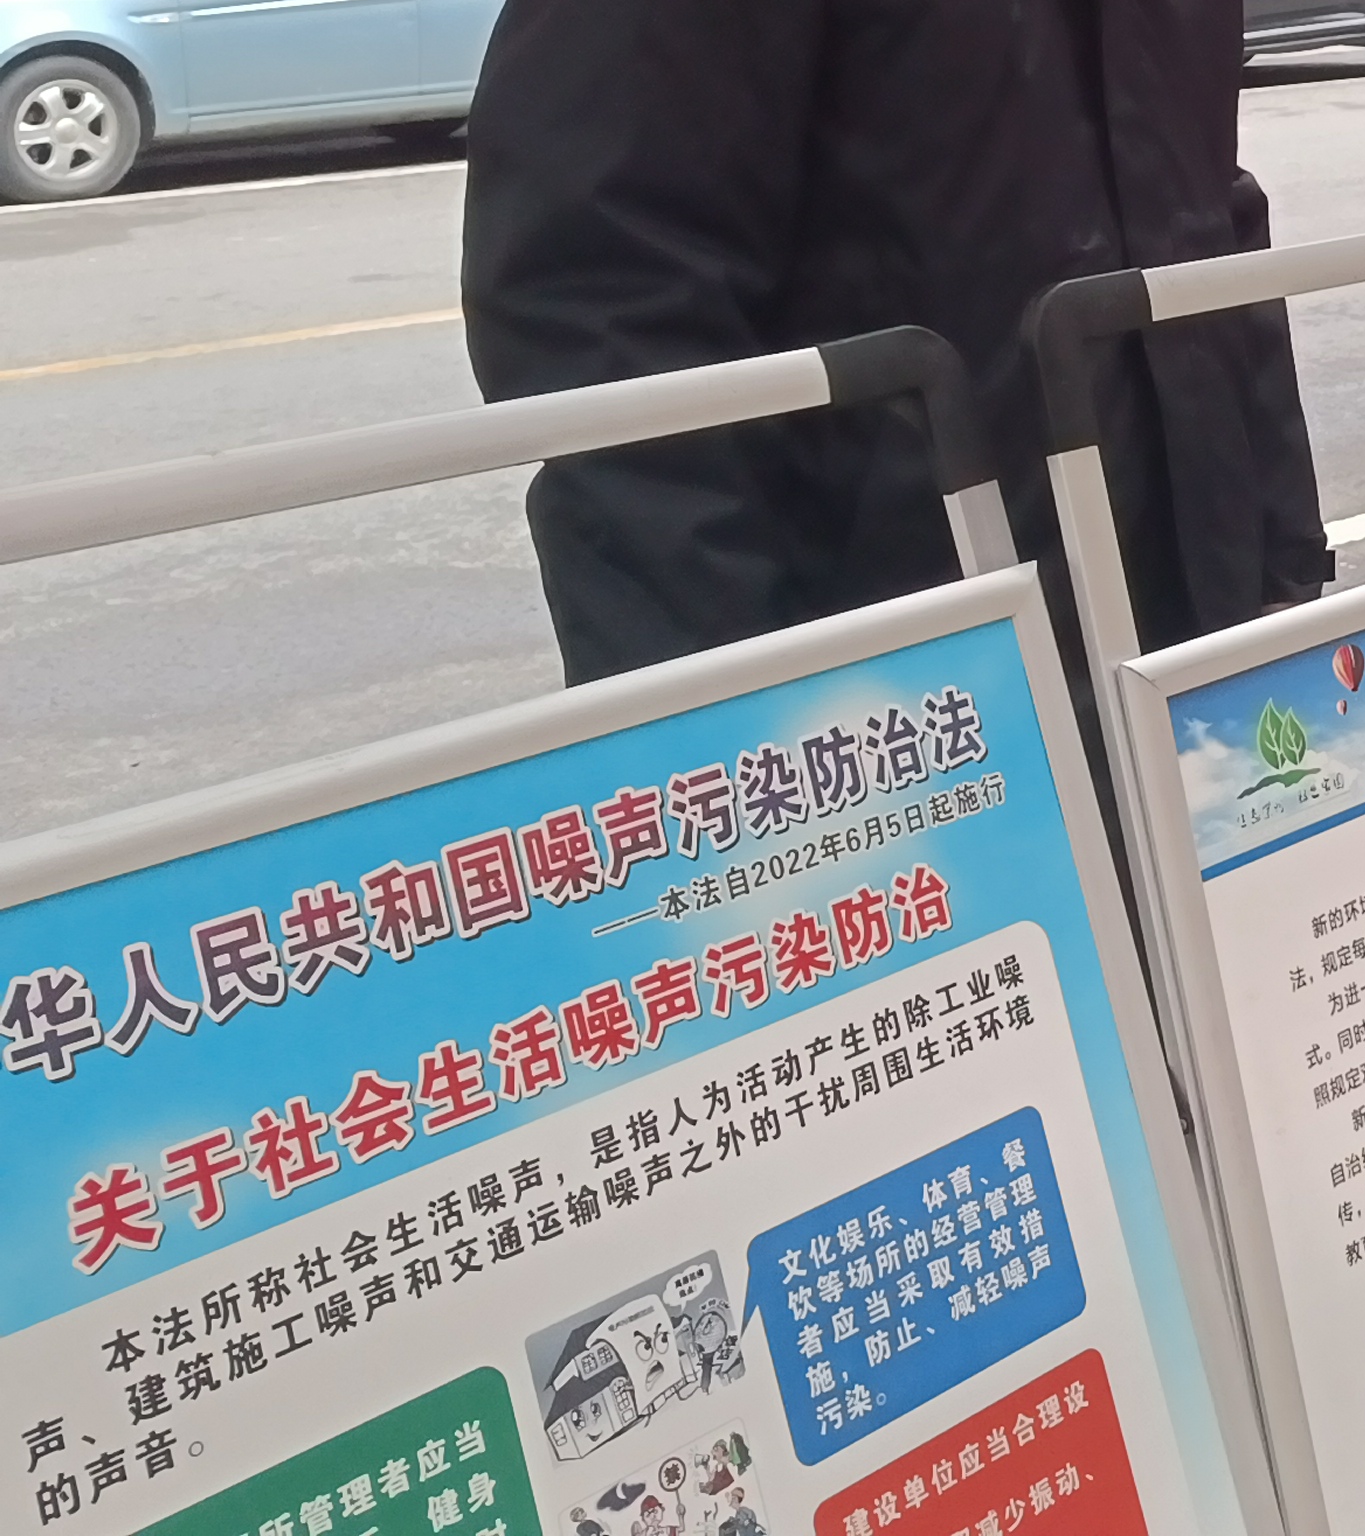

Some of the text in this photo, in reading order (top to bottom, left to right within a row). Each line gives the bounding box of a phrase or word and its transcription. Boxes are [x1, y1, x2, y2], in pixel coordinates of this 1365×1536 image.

[2, 682, 990, 1095] 华人民共和国噪声污染防治法
[70, 856, 956, 1279] 关于社会生活噪声污染防治
[23, 990, 1038, 1476] 声、建筑施工噪声和交通运输噪声之外的干扰周围生活环境
[99, 954, 1028, 1382] 本法所称社会生活噪声，是指人为活动产生的除工业噪
[775, 1133, 1029, 1286] 文化娱乐、体育、餐
[784, 1168, 1039, 1325] 饮等场所的经营管理
[793, 1204, 1048, 1365] 者应当采取有效措
[803, 1239, 1056, 1404] 施，防止、减轻噪声
[35, 1407, 209, 1531] 的声音。
[240, 1420, 487, 1536] 所管理者应当
[814, 1367, 891, 1440] 污染。
[842, 1380, 1090, 1536] 建设单位应当合理设
[950, 1463, 1094, 1536] 减少振动、
